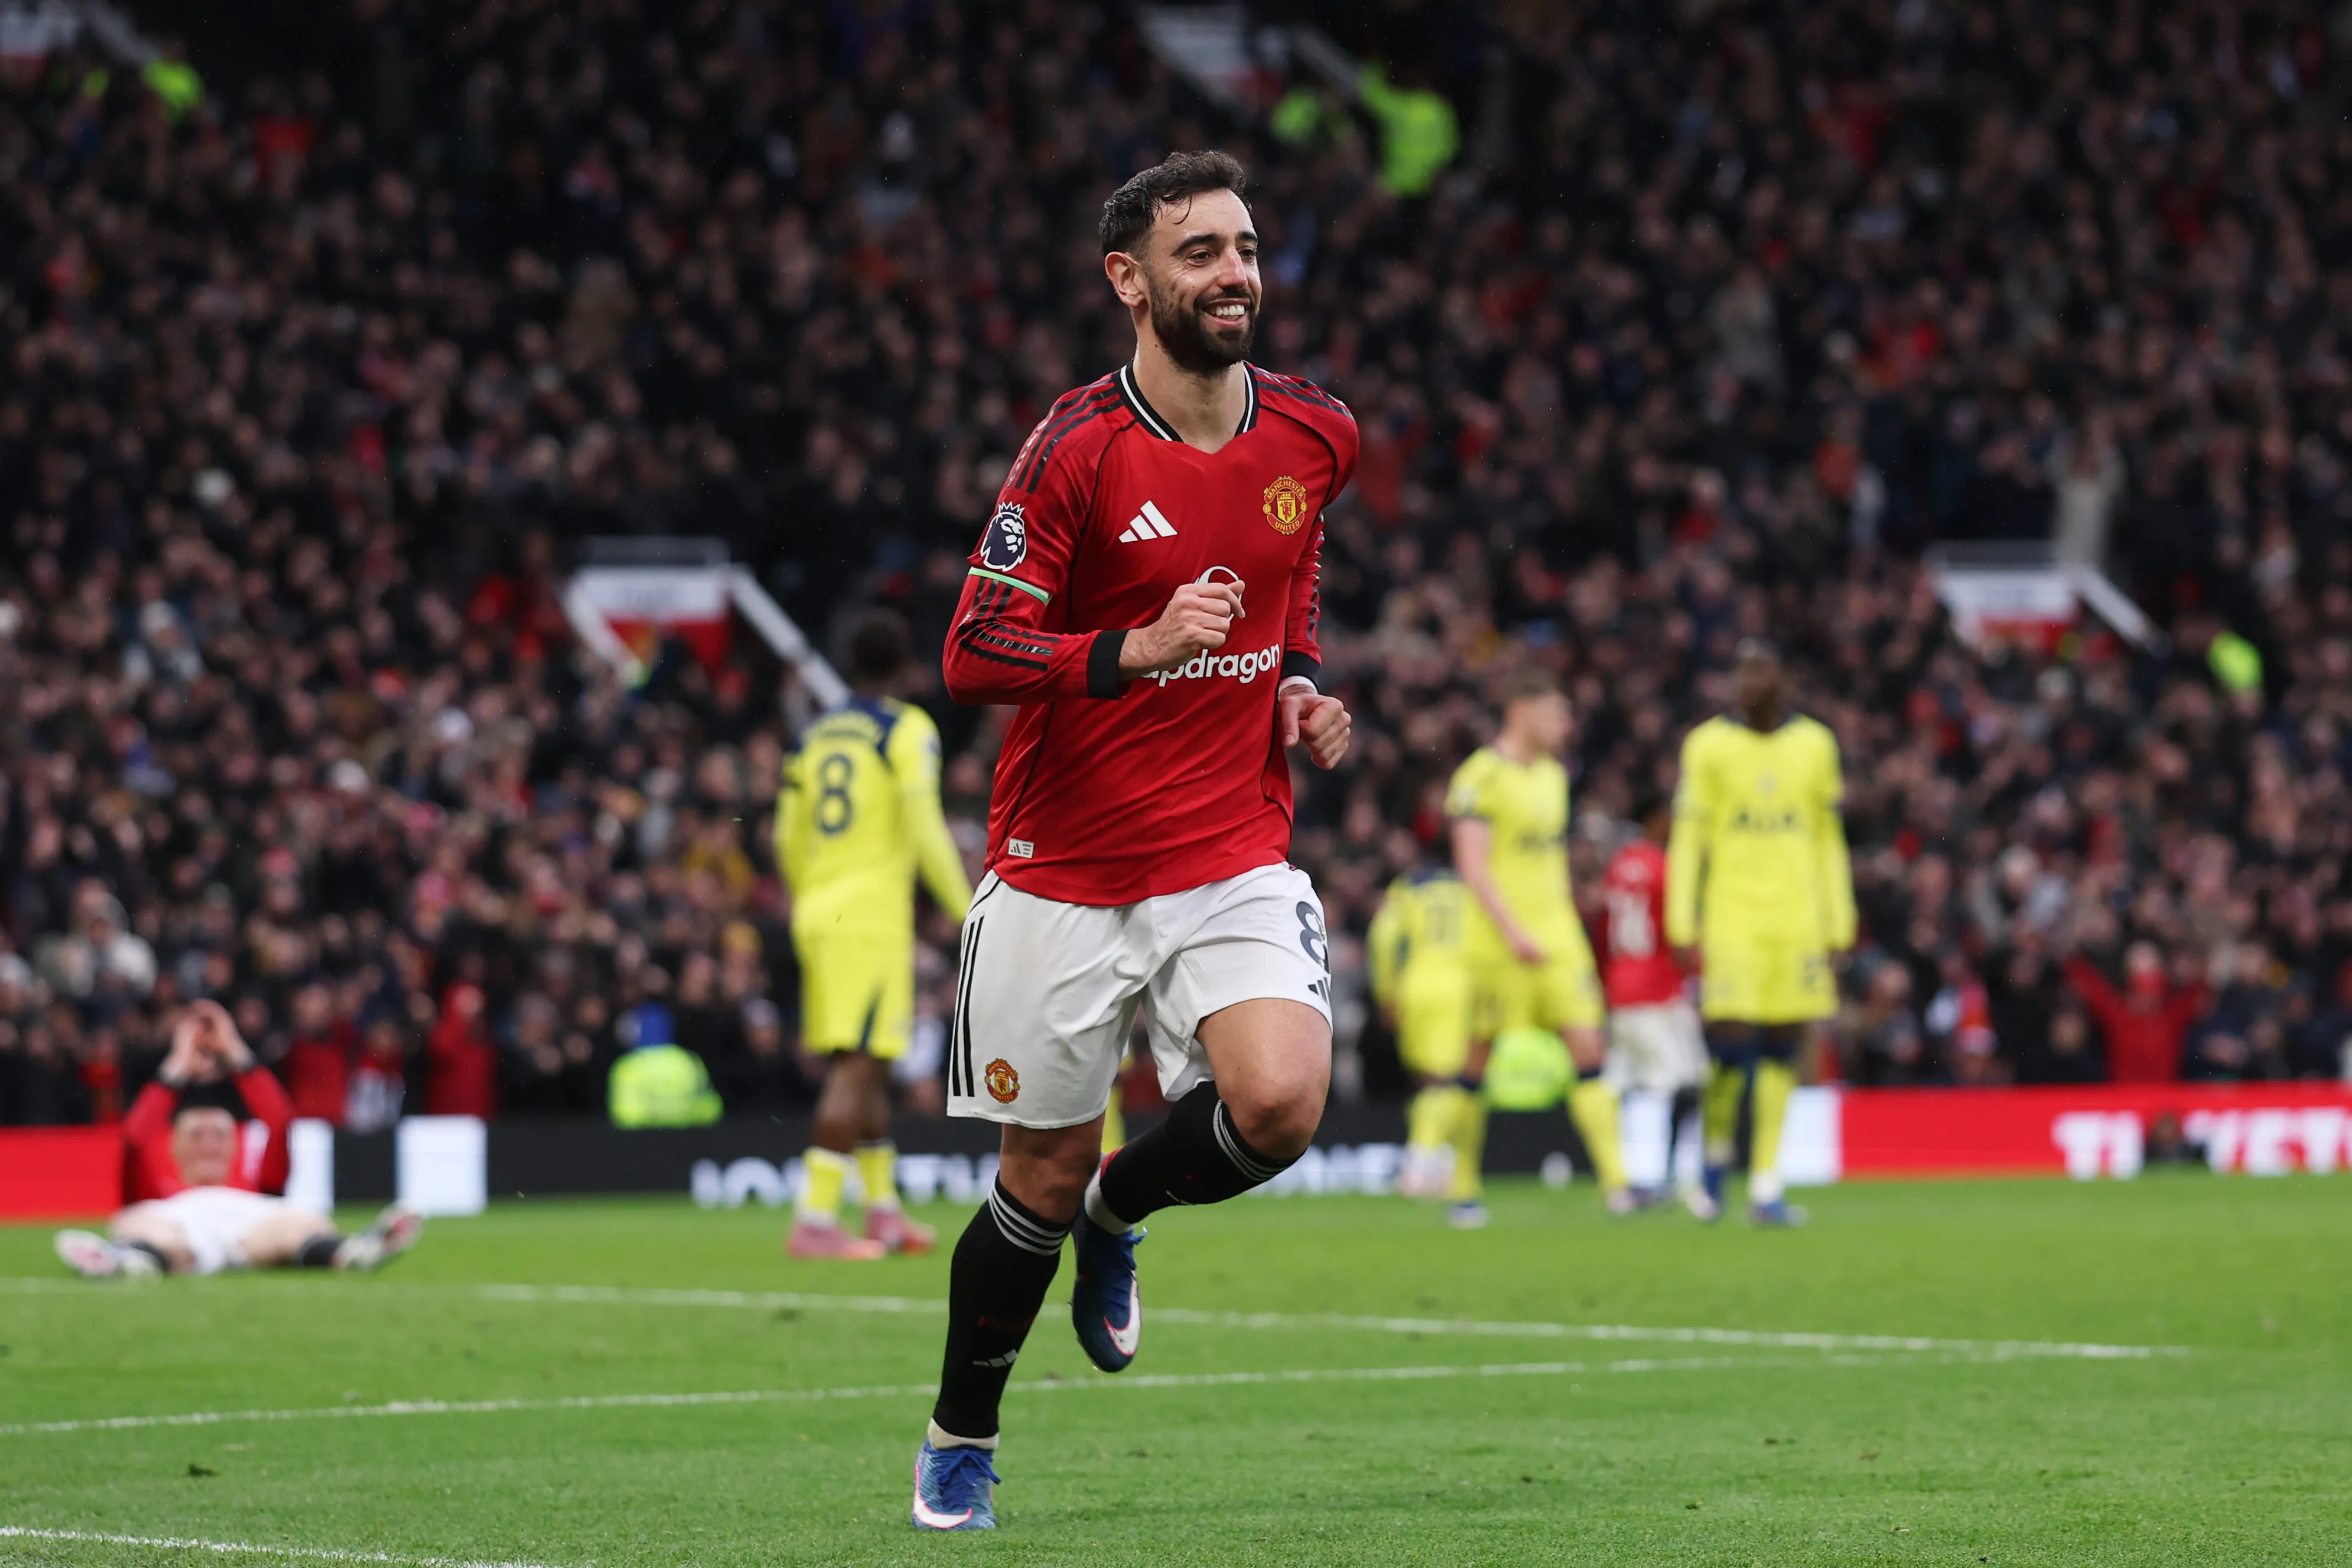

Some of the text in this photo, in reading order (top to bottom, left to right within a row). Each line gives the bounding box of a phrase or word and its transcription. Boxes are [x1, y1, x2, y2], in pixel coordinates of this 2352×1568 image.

[1267, 480, 1303, 500] MANCHESTER
[1275, 521, 1300, 531] UNITED
[1141, 643, 1280, 687] pdragon
[812, 753, 854, 837] 8
[1296, 901, 1330, 974] 8
